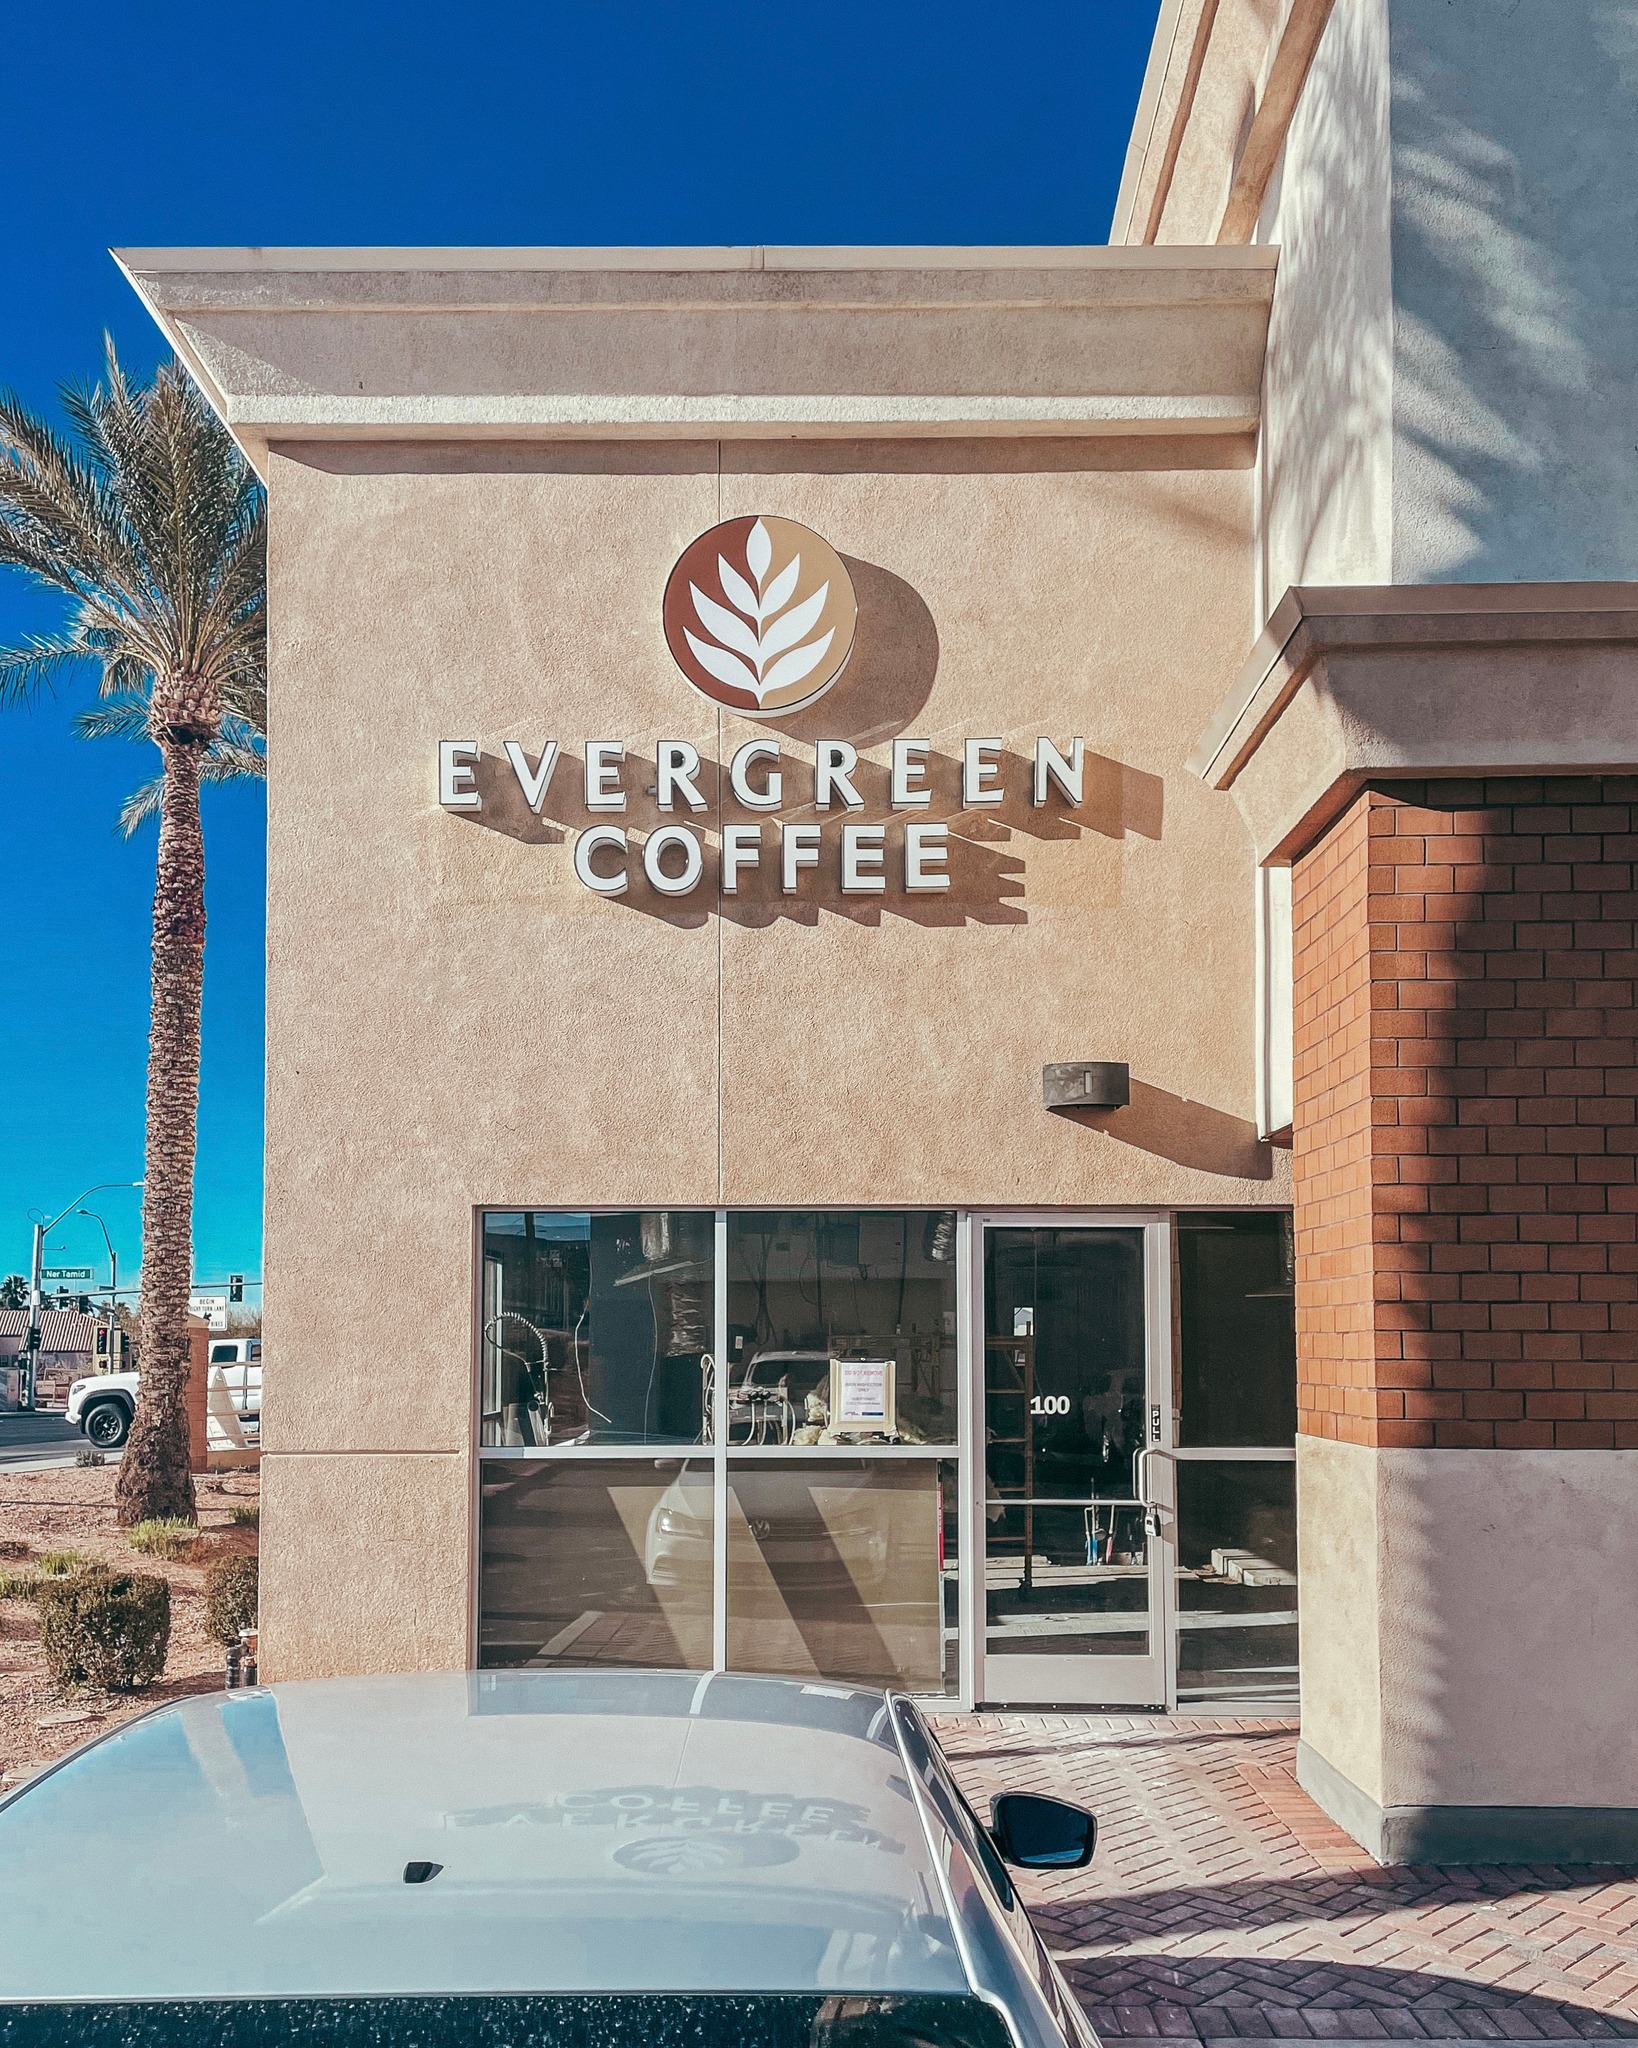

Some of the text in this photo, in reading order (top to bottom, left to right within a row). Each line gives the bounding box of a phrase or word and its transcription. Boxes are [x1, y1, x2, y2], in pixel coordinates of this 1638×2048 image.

[438, 737, 1084, 813] EVERGREEN
[574, 822, 951, 897] COFFEE
[1030, 1395, 1071, 1415] 100
[1152, 1410, 1160, 1442] PULL
